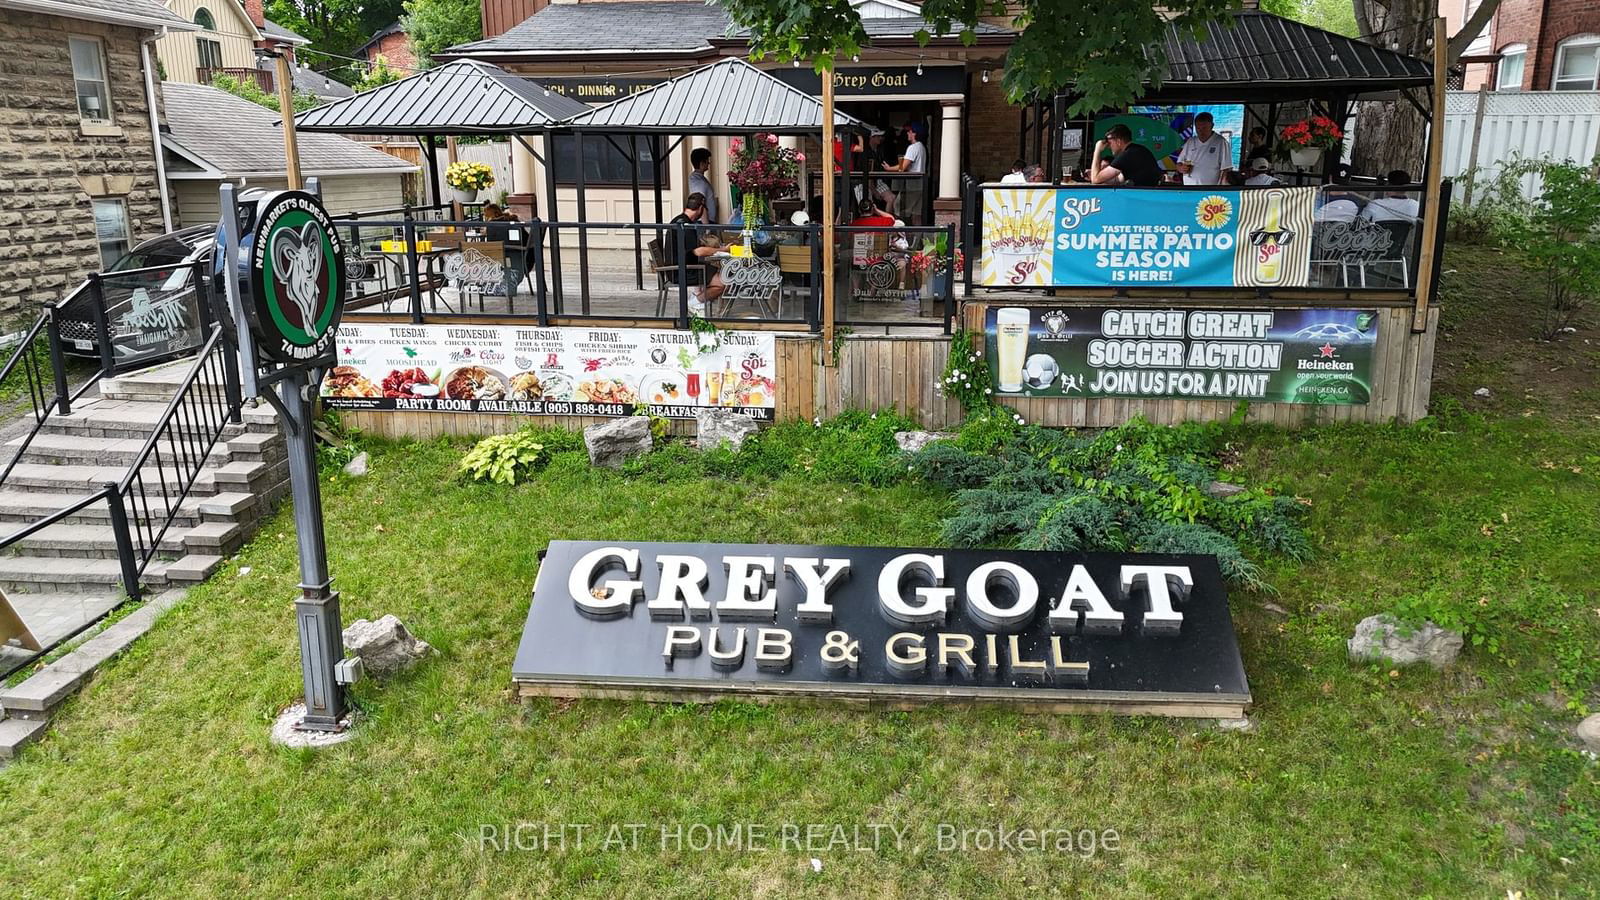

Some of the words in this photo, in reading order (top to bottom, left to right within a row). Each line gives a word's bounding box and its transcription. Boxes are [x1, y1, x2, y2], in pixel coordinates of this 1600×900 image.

[871, 72, 908, 87] Goat
[578, 85, 616, 96] DINNER
[256, 199, 298, 269] NEWMARKET'S
[299, 199, 329, 227] OLDEST
[327, 228, 340, 254] PUB
[1057, 233, 1158, 250] SUMMER
[1164, 233, 1233, 250] PATIO
[1321, 222, 1393, 250] Coors
[443, 253, 504, 281] Coors
[1096, 251, 1190, 268] SEASON
[720, 258, 782, 285] Coors
[1112, 270, 1126, 281] IS
[1129, 270, 1172, 281] HERE!
[722, 284, 779, 299] LIGHT
[335, 327, 363, 338] NDAY:
[1103, 311, 1185, 338] CATCH
[1189, 312, 1273, 339] GREAT
[390, 328, 429, 338] TUESDAY:
[447, 329, 501, 340] WEDNESDAY:
[516, 330, 563, 341] THURSDAY:
[588, 332, 622, 342] FRIDAY:
[723, 335, 760, 346] SUNDAY:
[281, 339, 294, 356] 74
[293, 344, 318, 360] MAIN
[317, 333, 329, 352] ST
[326, 325, 335, 338] S
[479, 350, 505, 360] Coors
[1088, 340, 1184, 367] SOCCER
[1187, 342, 1282, 369] ACTION
[387, 358, 438, 367] MOOSEHEAD
[1297, 359, 1354, 370] Heineken
[1091, 370, 1137, 393] JOIN
[1140, 371, 1165, 394] US
[1168, 372, 1205, 395] FOR
[1208, 373, 1223, 395] A
[1226, 374, 1269, 396] PINT
[1297, 373, 1315, 381] open
[396, 398, 433, 410] PARTY
[437, 400, 471, 411] ROOM
[478, 400, 541, 413] AVAILABLE
[544, 401, 572, 415] (905)
[575, 403, 624, 415] 898-0418
[641, 405, 705, 417] BREAKFAS
[568, 547, 850, 618] GREY
[878, 553, 1193, 624] GOAT
[663, 626, 793, 666] PUB
[820, 630, 859, 666] &
[885, 632, 1090, 672] GRILL
